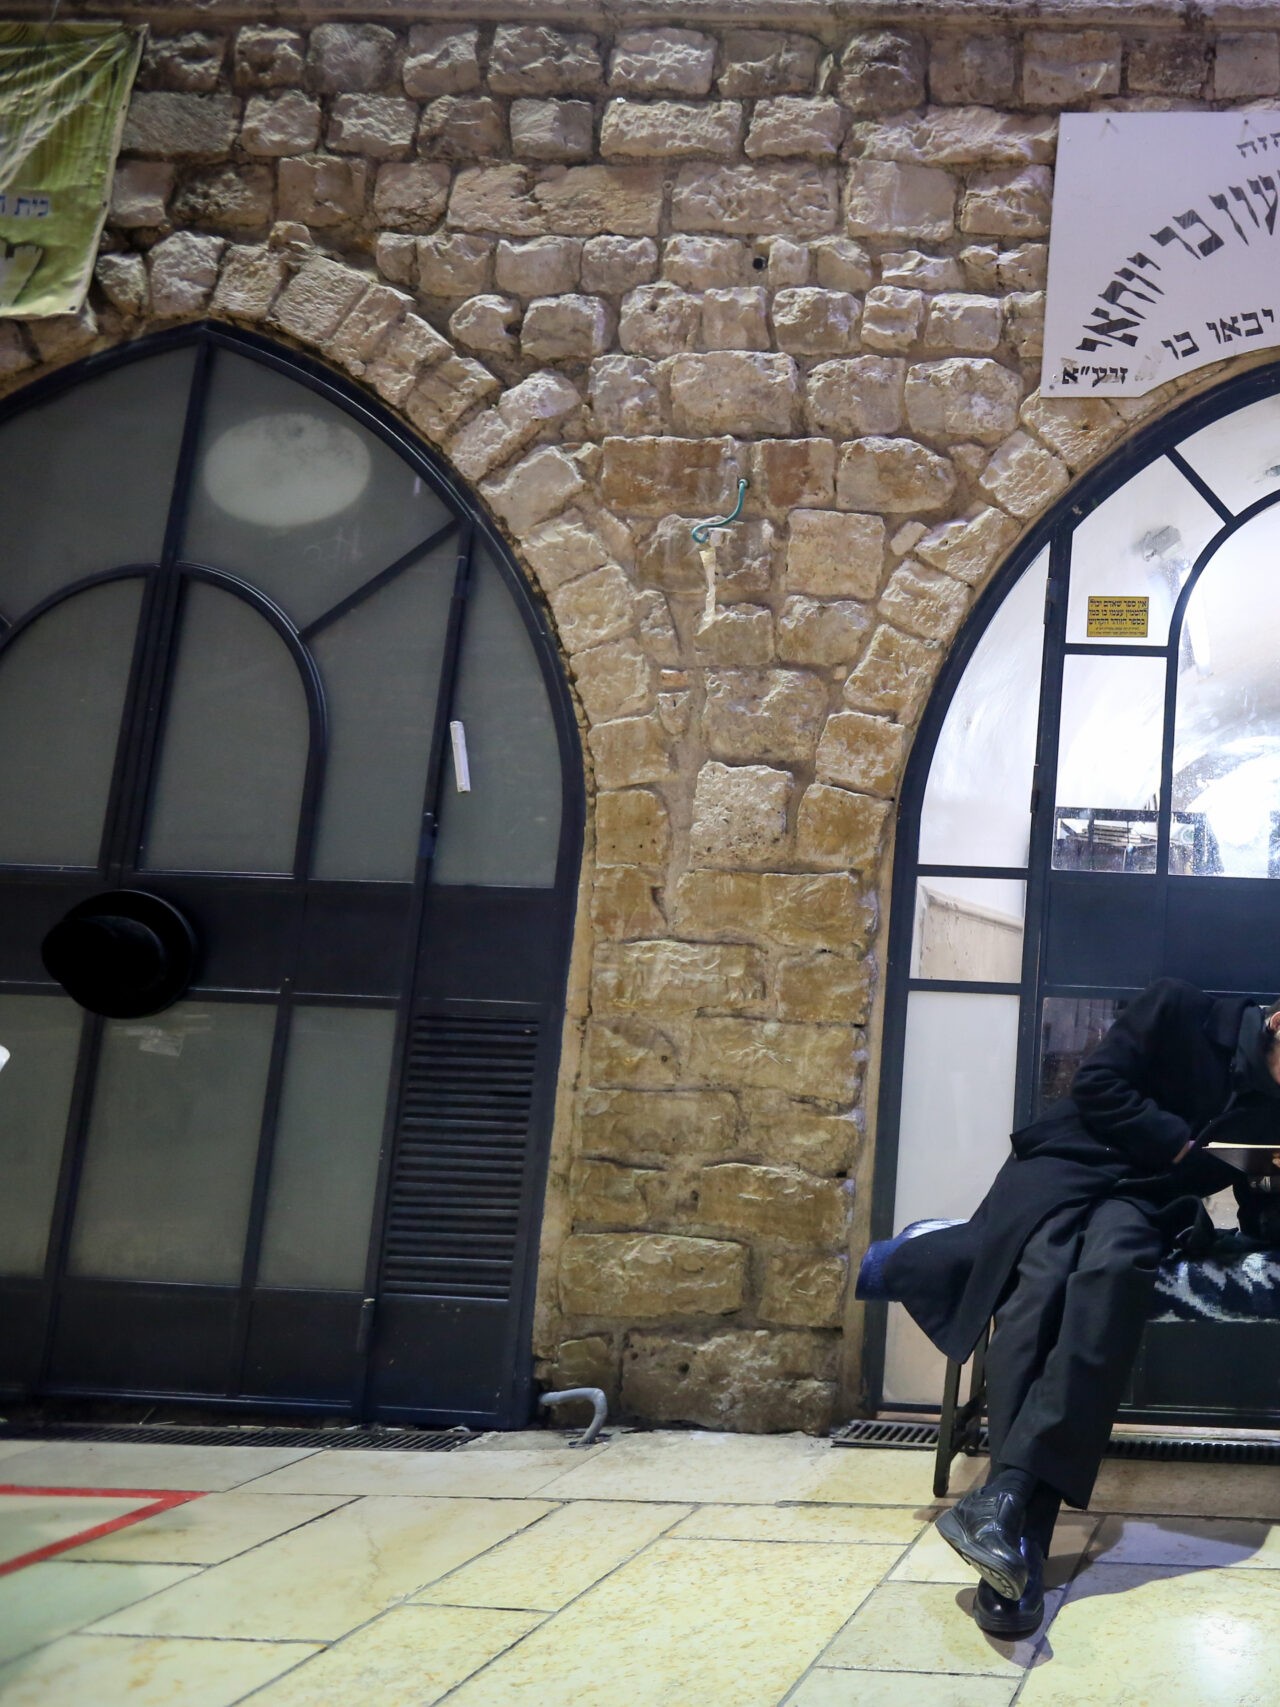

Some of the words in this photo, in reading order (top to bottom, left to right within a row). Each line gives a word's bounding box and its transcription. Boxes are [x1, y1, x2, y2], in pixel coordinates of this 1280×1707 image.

[1151, 209, 1224, 260] בר
[1075, 252, 1164, 352] יוחאי
[1161, 331, 1200, 360] בו
[1206, 308, 1280, 347] יבאו
